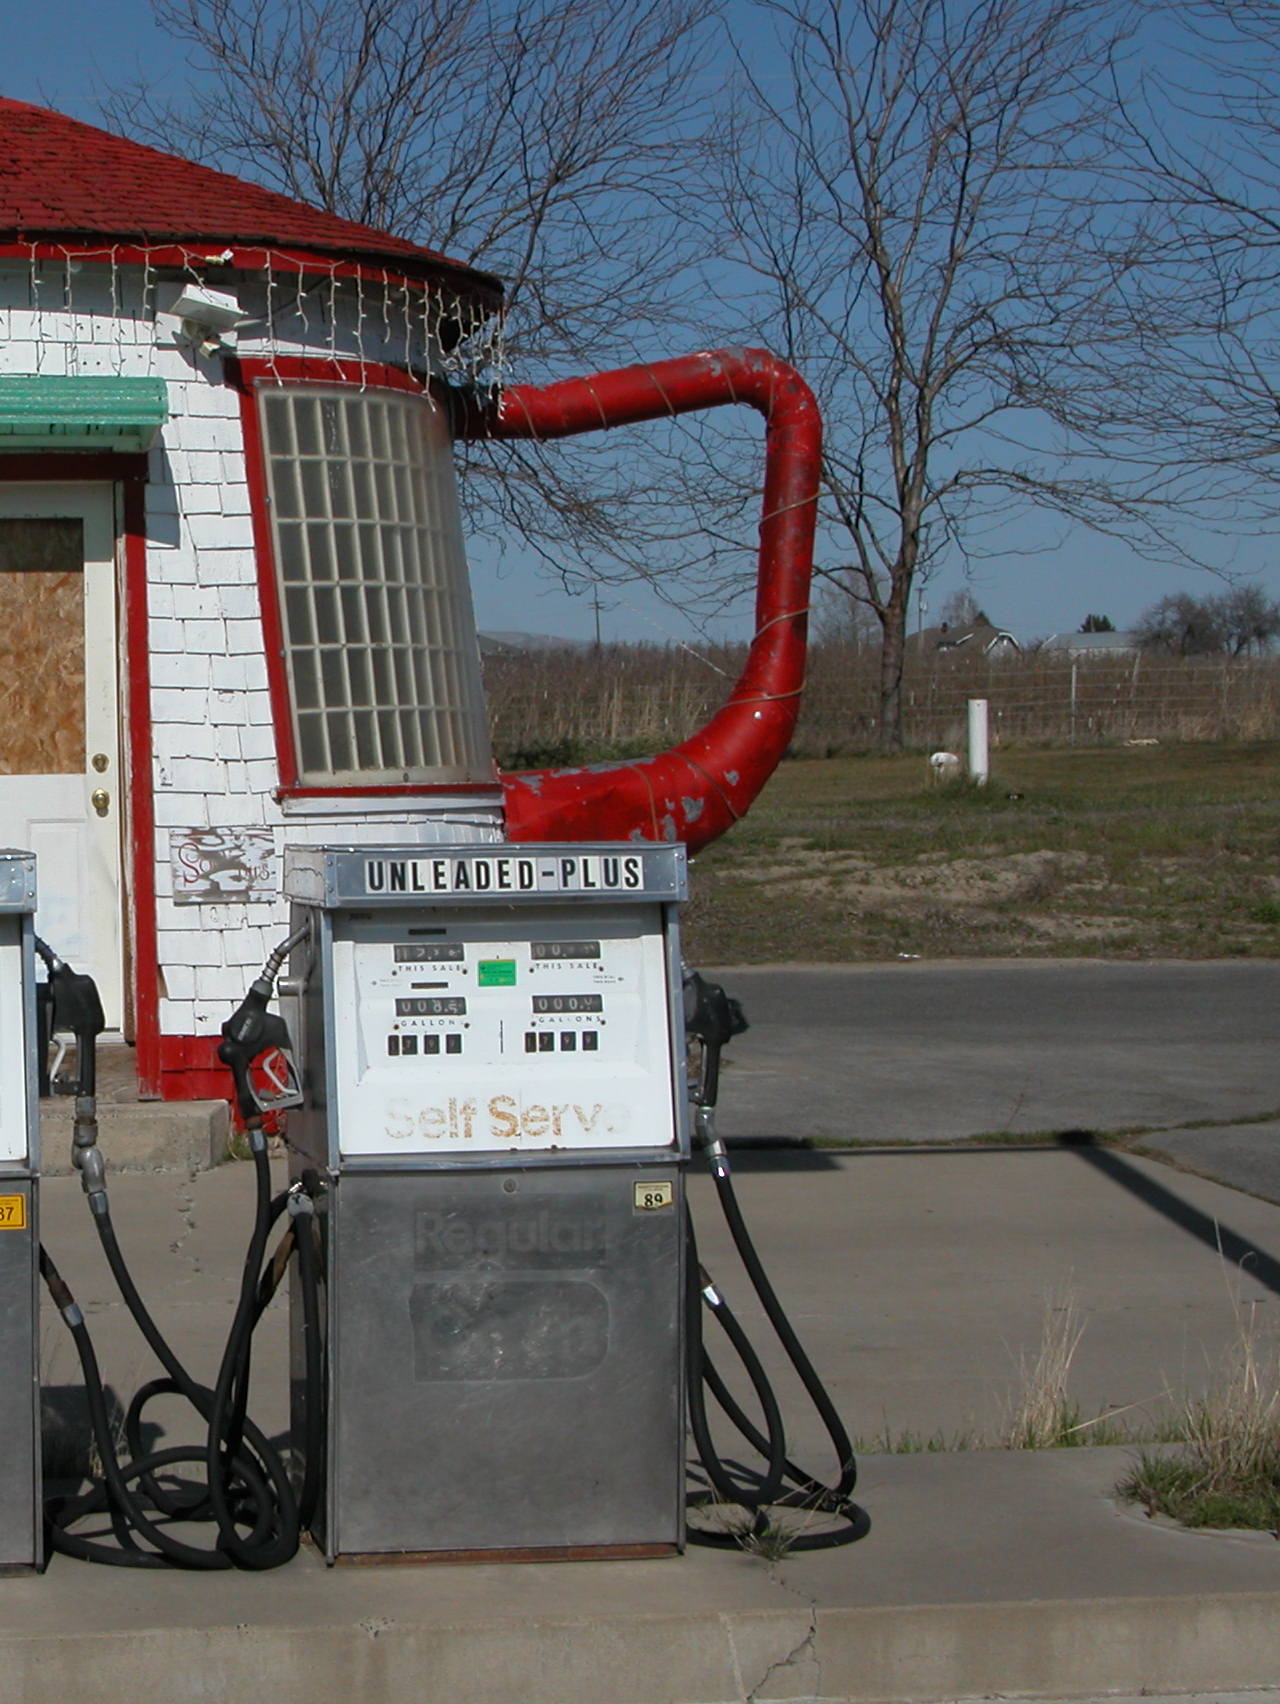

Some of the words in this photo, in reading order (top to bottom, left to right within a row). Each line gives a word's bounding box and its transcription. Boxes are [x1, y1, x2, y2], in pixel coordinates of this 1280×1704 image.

[368, 857, 640, 892] UNLEADED-PLUS
[384, 1096, 478, 1139] Self
[645, 1193, 663, 1207] 89
